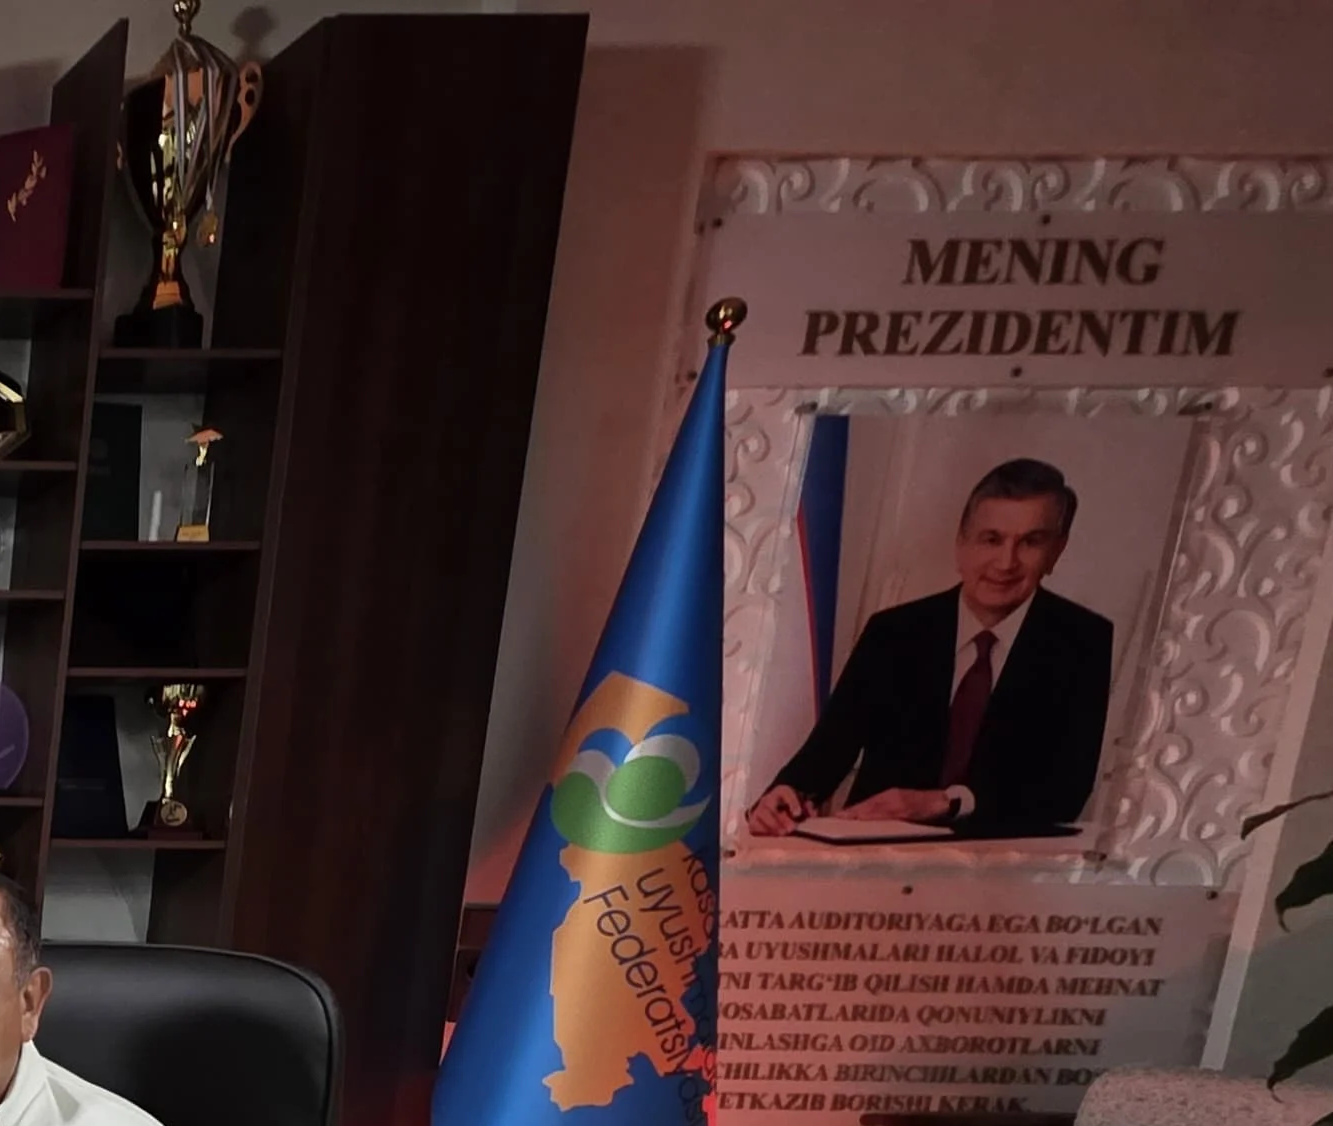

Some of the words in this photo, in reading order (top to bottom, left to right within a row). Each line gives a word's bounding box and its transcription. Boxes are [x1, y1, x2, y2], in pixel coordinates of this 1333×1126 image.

[901, 237, 1166, 287] MENING
[797, 309, 1242, 357] PREZIDENTIM
[720, 909, 785, 930] ATTA
[788, 910, 982, 933] AUDITORIYAGA
[986, 913, 1041, 934] EGA
[745, 941, 931, 962] UYUSHMALARI
[935, 944, 1024, 964] HALOL
[1029, 945, 1060, 966] VA
[1065, 946, 1157, 967] FIDOYI
[863, 973, 950, 996] QILISH
[954, 975, 1050, 995] HAMDA
[1055, 977, 1166, 998] MEHNAT
[719, 1002, 911, 1023] OSABATLARIDA
[916, 1004, 1109, 1028] QONUNIYLIKNI
[718, 1032, 844, 1053] INLASHGA
[848, 1034, 896, 1053] OID
[898, 1034, 1103, 1056] AXBOROTLARNI
[833, 1063, 1054, 1085] BIRINCHILARDAN
[717, 1091, 825, 1112] ETKAZIB
[829, 1093, 933, 1113] BORISHI
